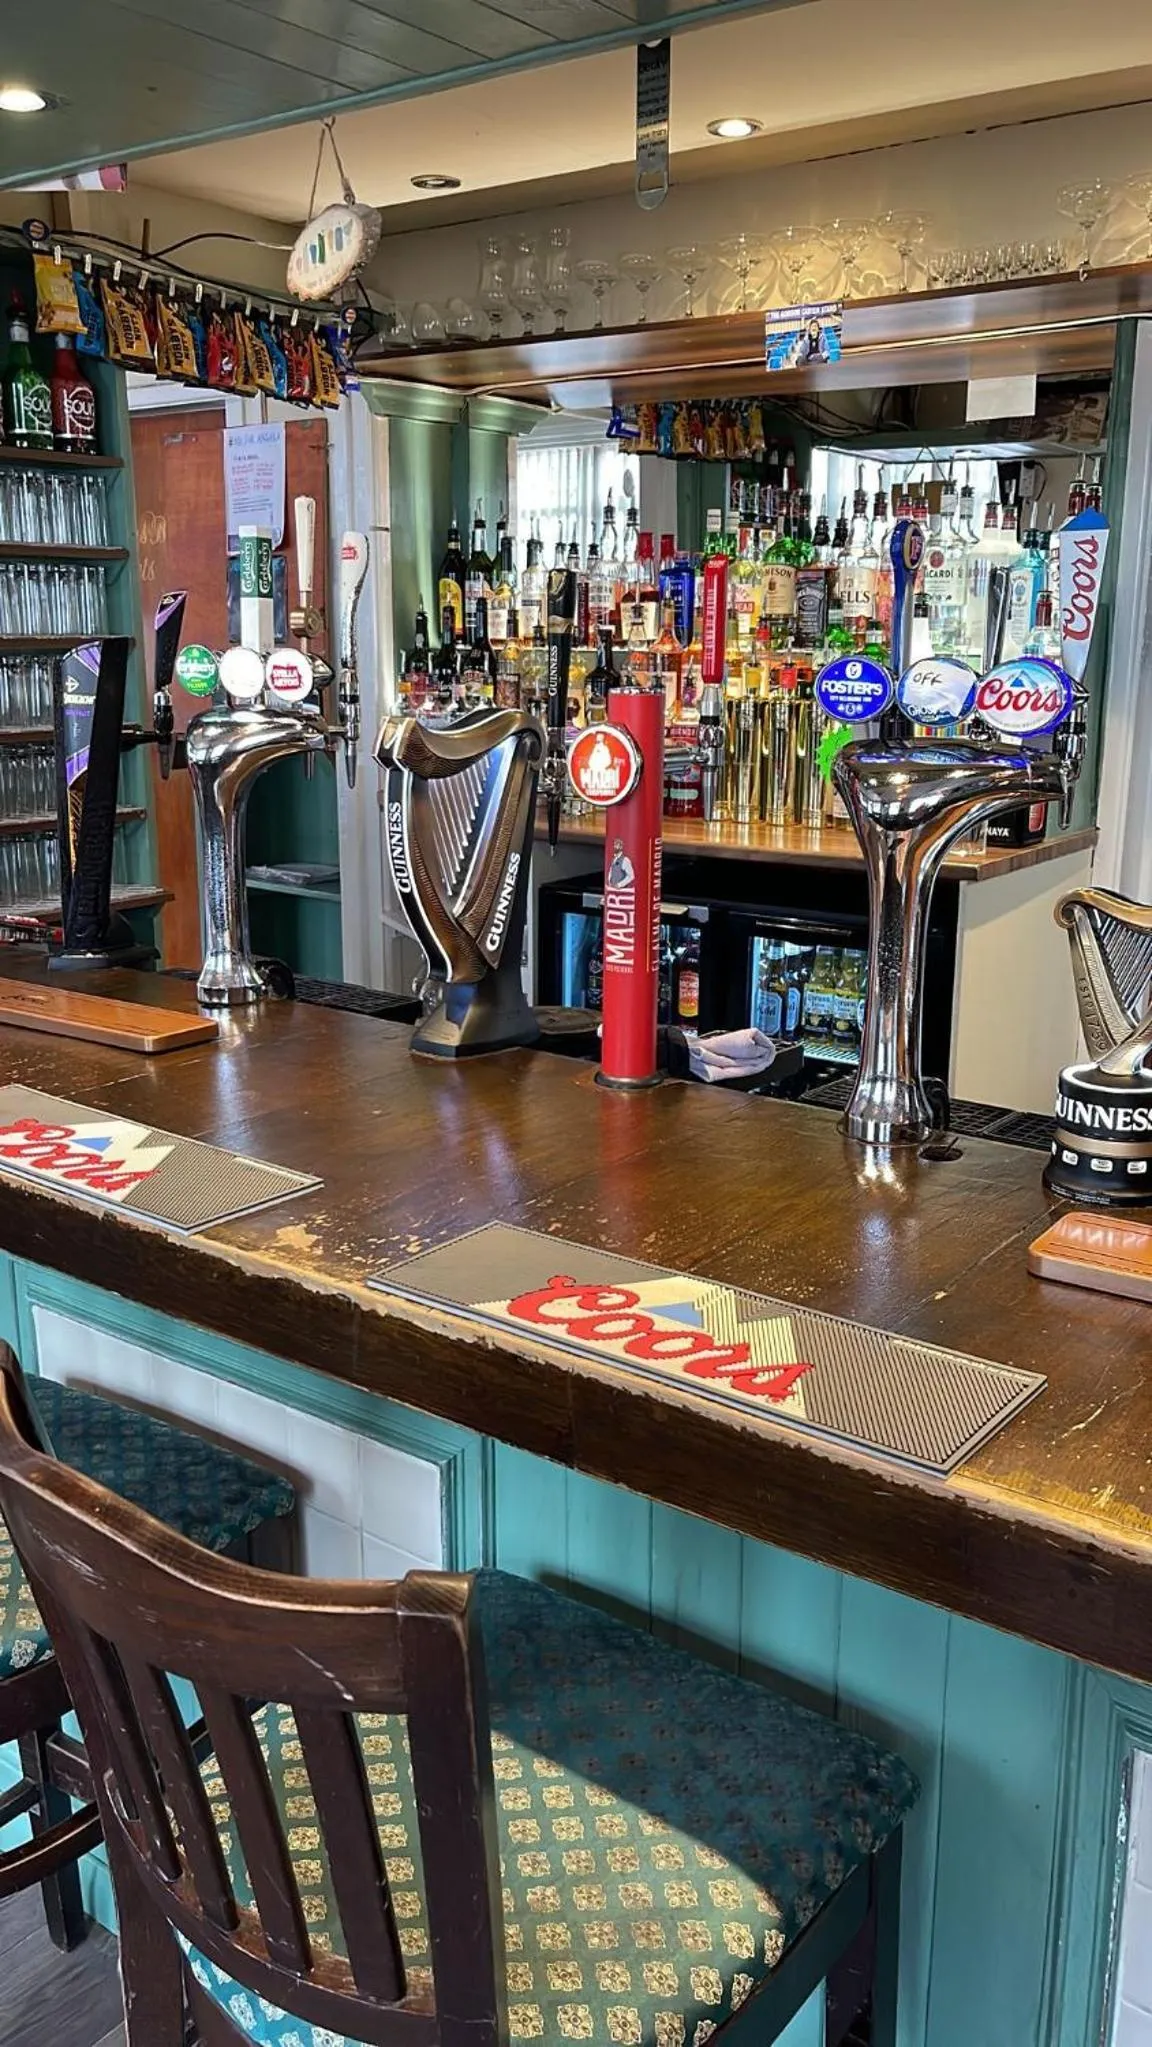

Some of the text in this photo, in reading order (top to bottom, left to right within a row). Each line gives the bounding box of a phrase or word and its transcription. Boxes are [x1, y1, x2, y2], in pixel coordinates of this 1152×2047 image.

[259, 542, 272, 593] Carlsberg
[1063, 535, 1100, 641] Coors
[548, 645, 558, 697] GUINNESS
[821, 679, 883, 696] FOSTER'S
[913, 671, 943, 685] OFF
[976, 678, 1062, 712] Coors
[389, 801, 411, 894] GUINNESS
[486, 852, 520, 951] GUINNESS
[1055, 1093, 1152, 1131] UINNES
[507, 1275, 816, 1403] Coors
